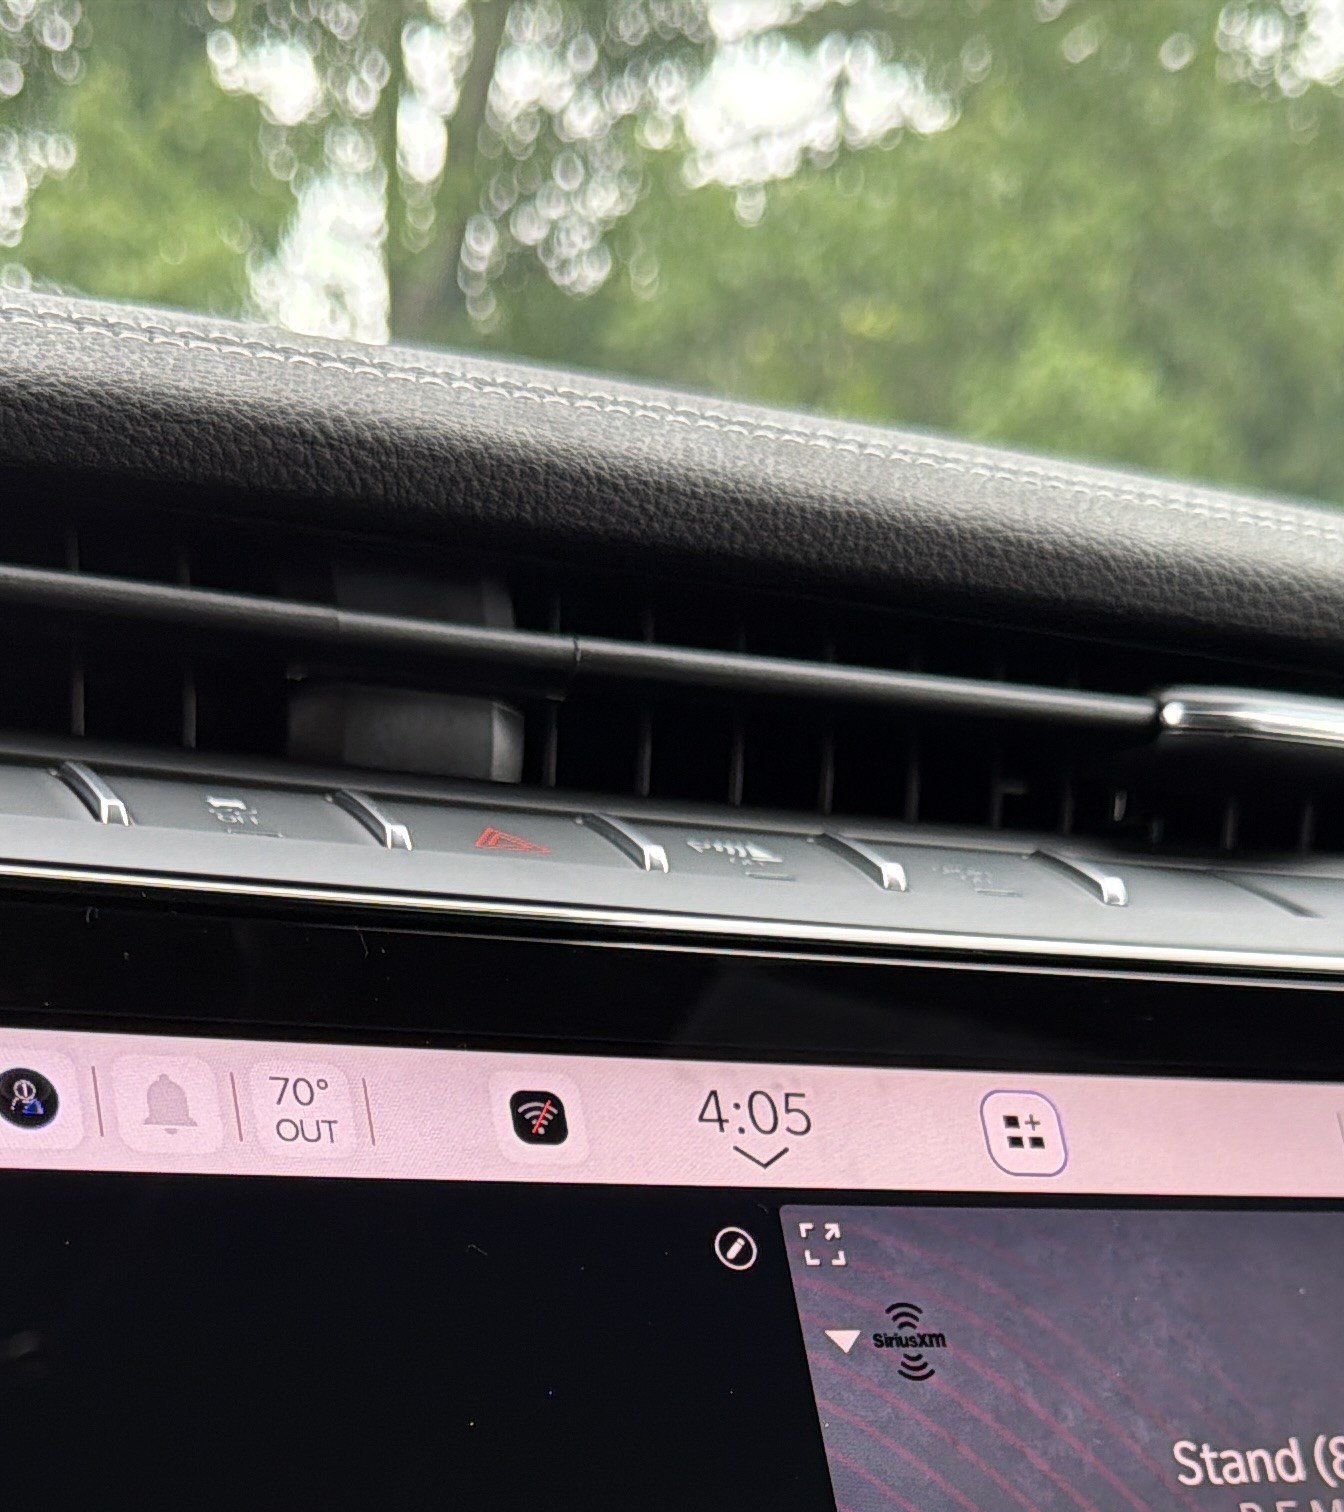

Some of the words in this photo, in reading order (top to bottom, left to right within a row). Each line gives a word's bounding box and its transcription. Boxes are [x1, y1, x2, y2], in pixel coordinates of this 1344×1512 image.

[268, 1076, 329, 1107] 70°
[275, 1118, 338, 1144] OUT
[698, 1089, 812, 1136] 4:05
[1172, 1436, 1307, 1486] Stand
